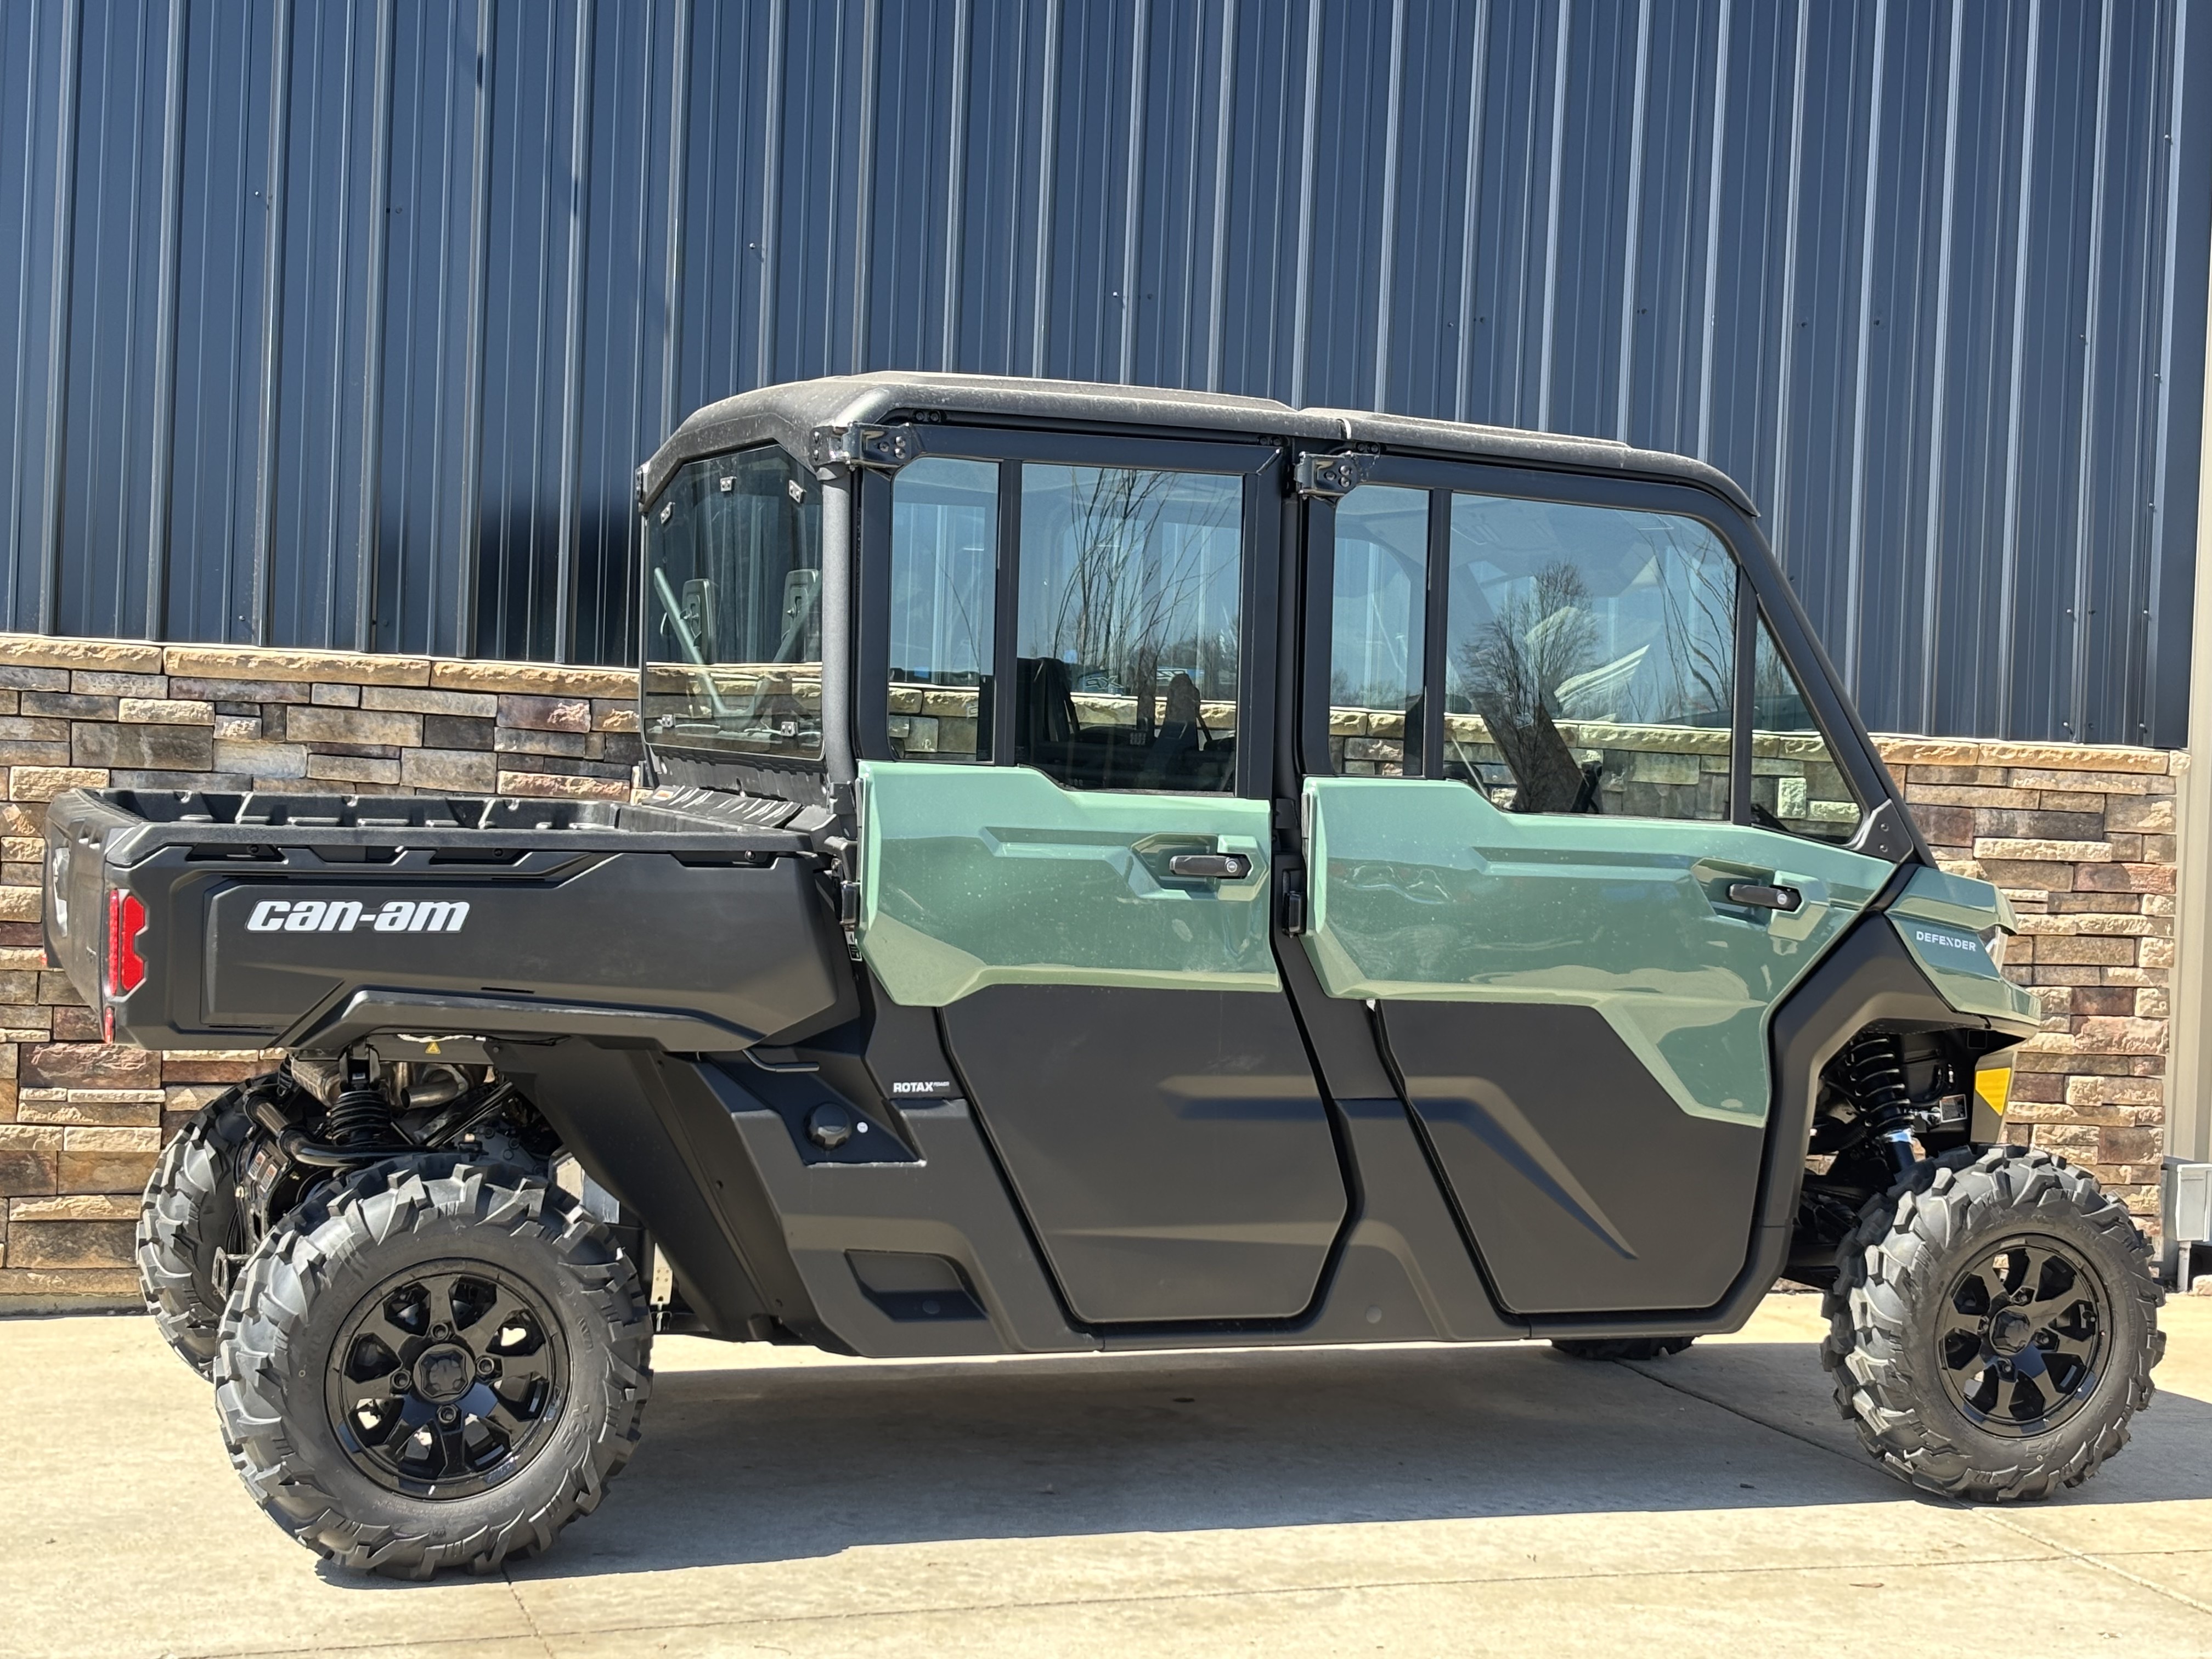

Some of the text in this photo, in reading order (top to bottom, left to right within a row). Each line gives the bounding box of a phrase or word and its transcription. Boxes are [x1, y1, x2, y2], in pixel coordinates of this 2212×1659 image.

[247, 900, 470, 932] can-am
[1916, 931, 1976, 951] DEFENDER
[893, 1082, 933, 1092] ROTAX
